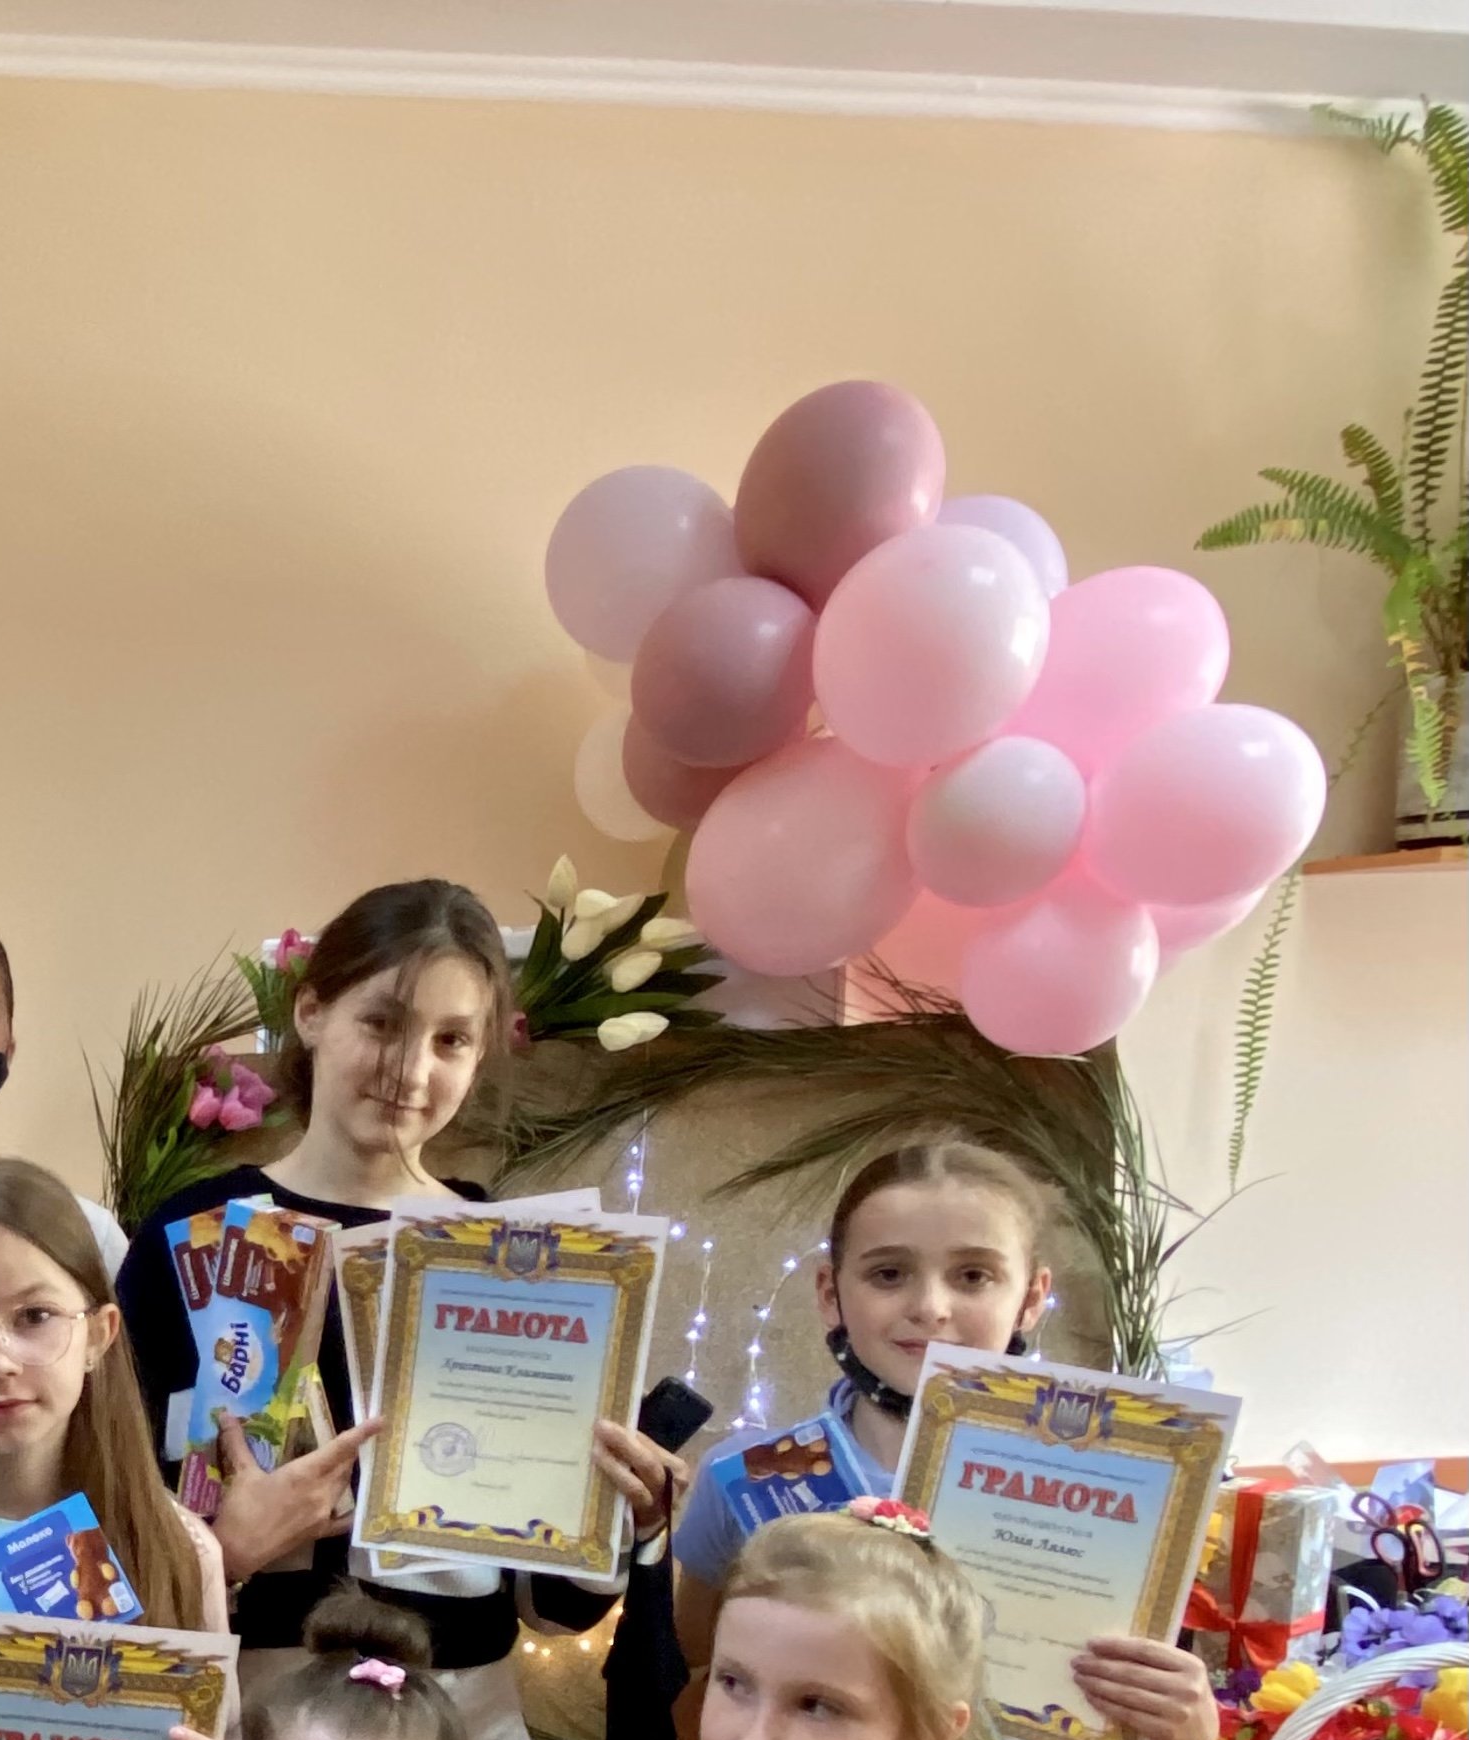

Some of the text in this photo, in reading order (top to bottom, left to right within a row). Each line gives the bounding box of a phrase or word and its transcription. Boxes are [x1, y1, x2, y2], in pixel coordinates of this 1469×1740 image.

[434, 1303, 589, 1344] ГРАМОТА
[221, 1322, 250, 1394] Барні
[958, 1461, 1138, 1523] ГРАМОТА
[7, 1526, 54, 1555] Молоко
